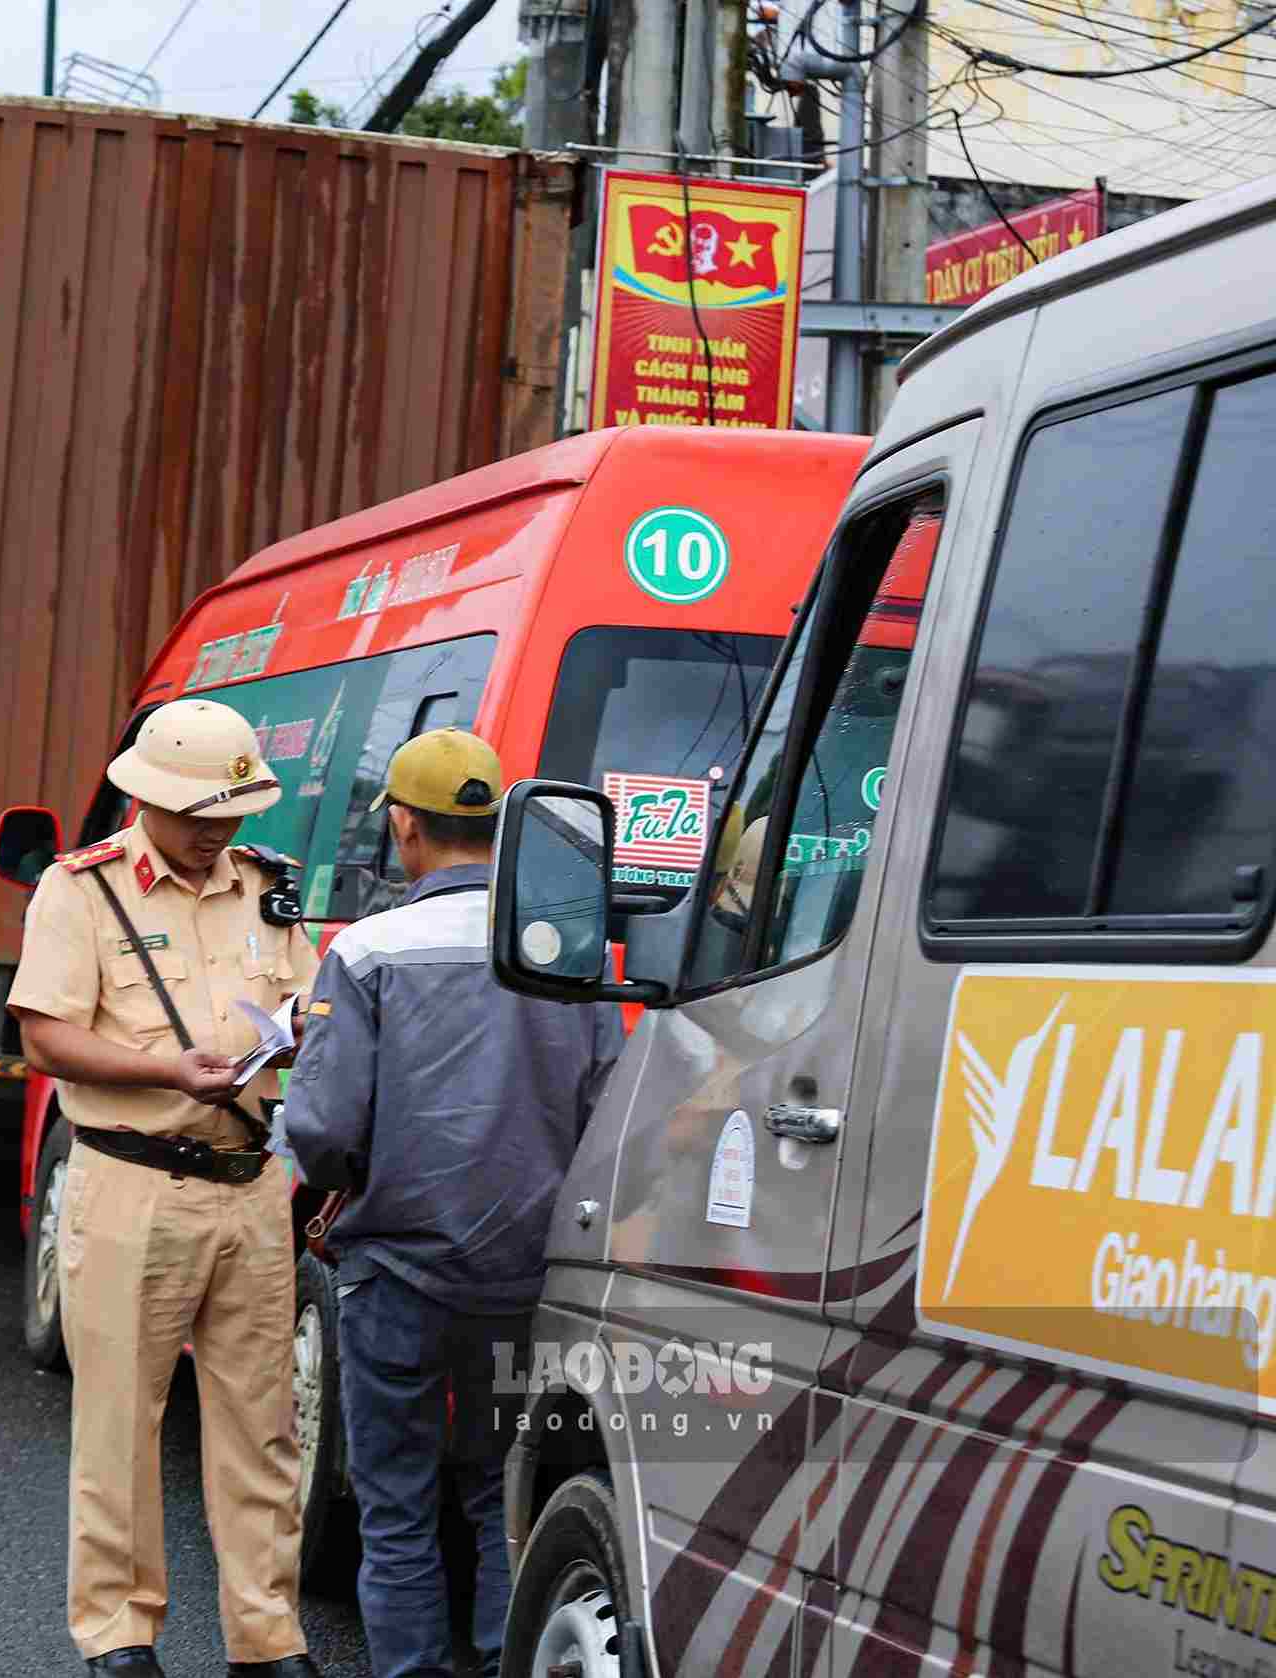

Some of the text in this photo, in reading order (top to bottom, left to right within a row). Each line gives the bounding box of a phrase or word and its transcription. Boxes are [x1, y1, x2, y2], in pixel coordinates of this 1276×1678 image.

[647, 334, 692, 354] TINH
[635, 359, 750, 386] CÁCH MẠNG
[636, 384, 699, 408] THÁNG
[642, 527, 712, 580] 10
[1091, 1232, 1175, 1327] Giao
